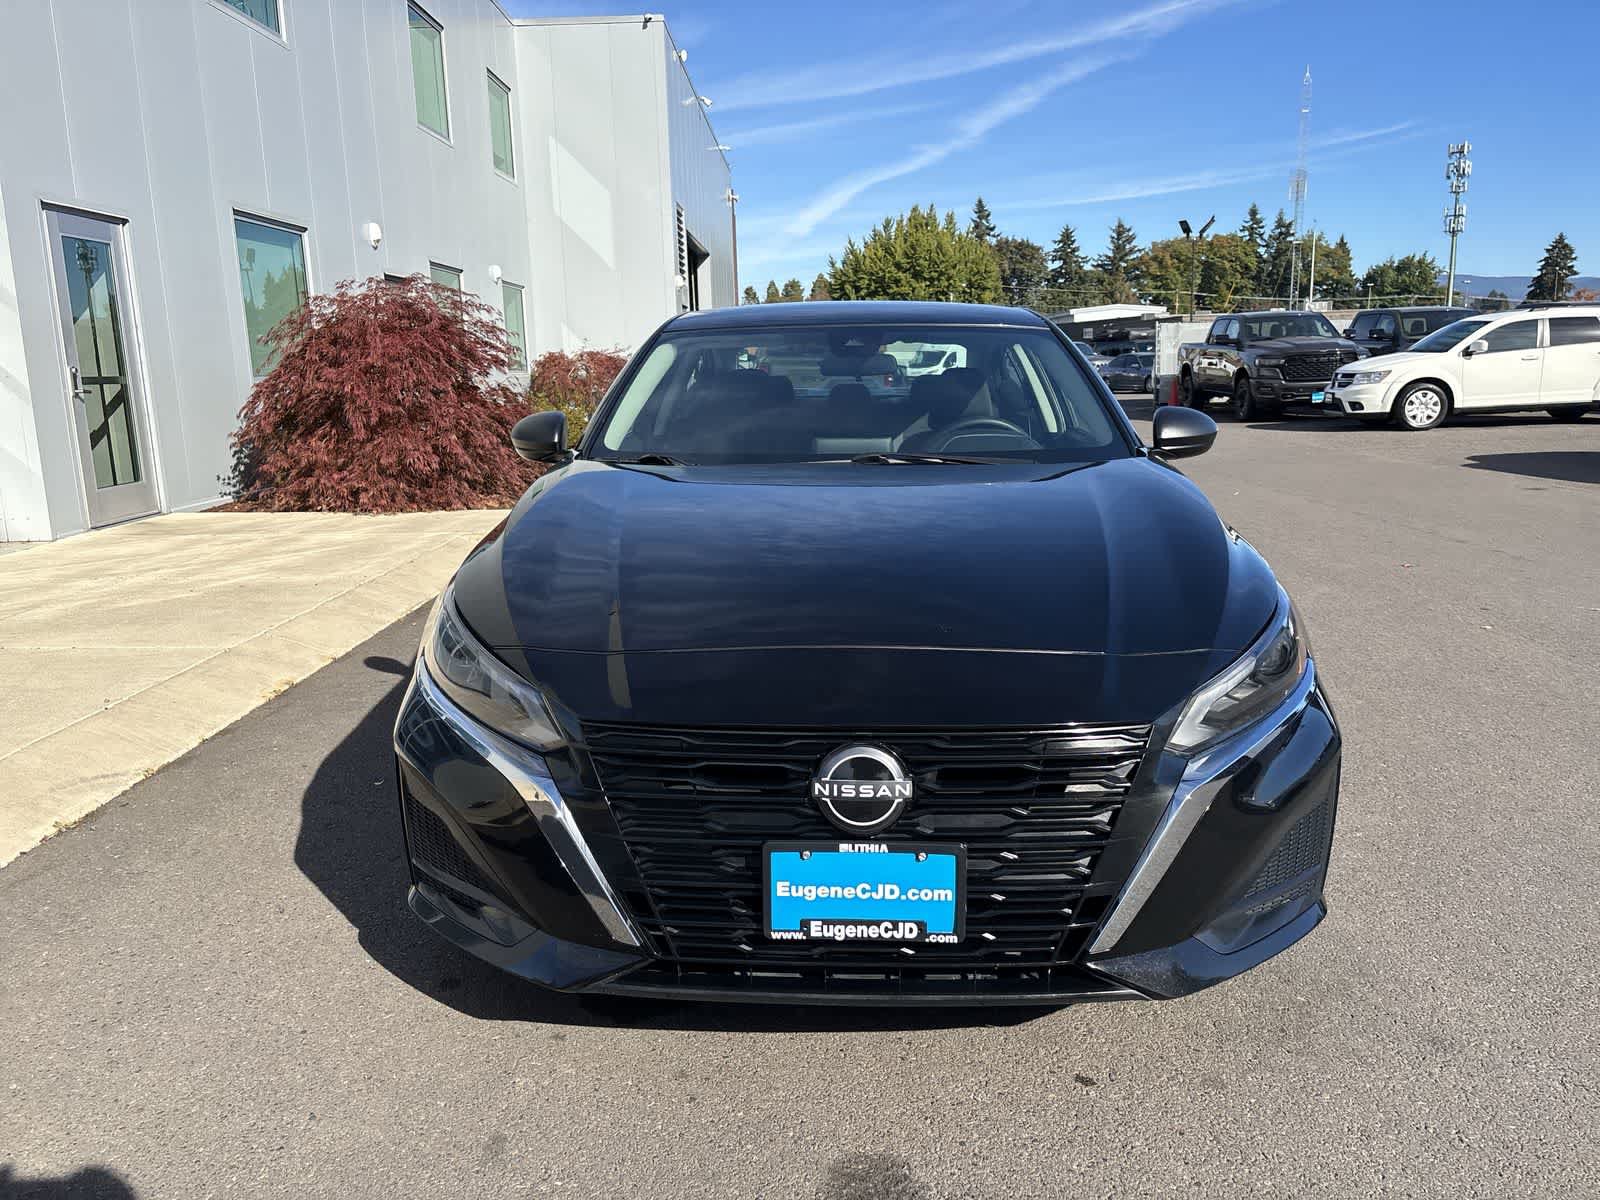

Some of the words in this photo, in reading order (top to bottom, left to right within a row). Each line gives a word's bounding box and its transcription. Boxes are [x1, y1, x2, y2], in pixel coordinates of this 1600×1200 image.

[814, 783, 912, 798] NISSAN
[848, 843, 888, 853] LITHIA
[776, 881, 953, 901] EugeneCJD.com
[810, 920, 919, 940] EugeneCJD
